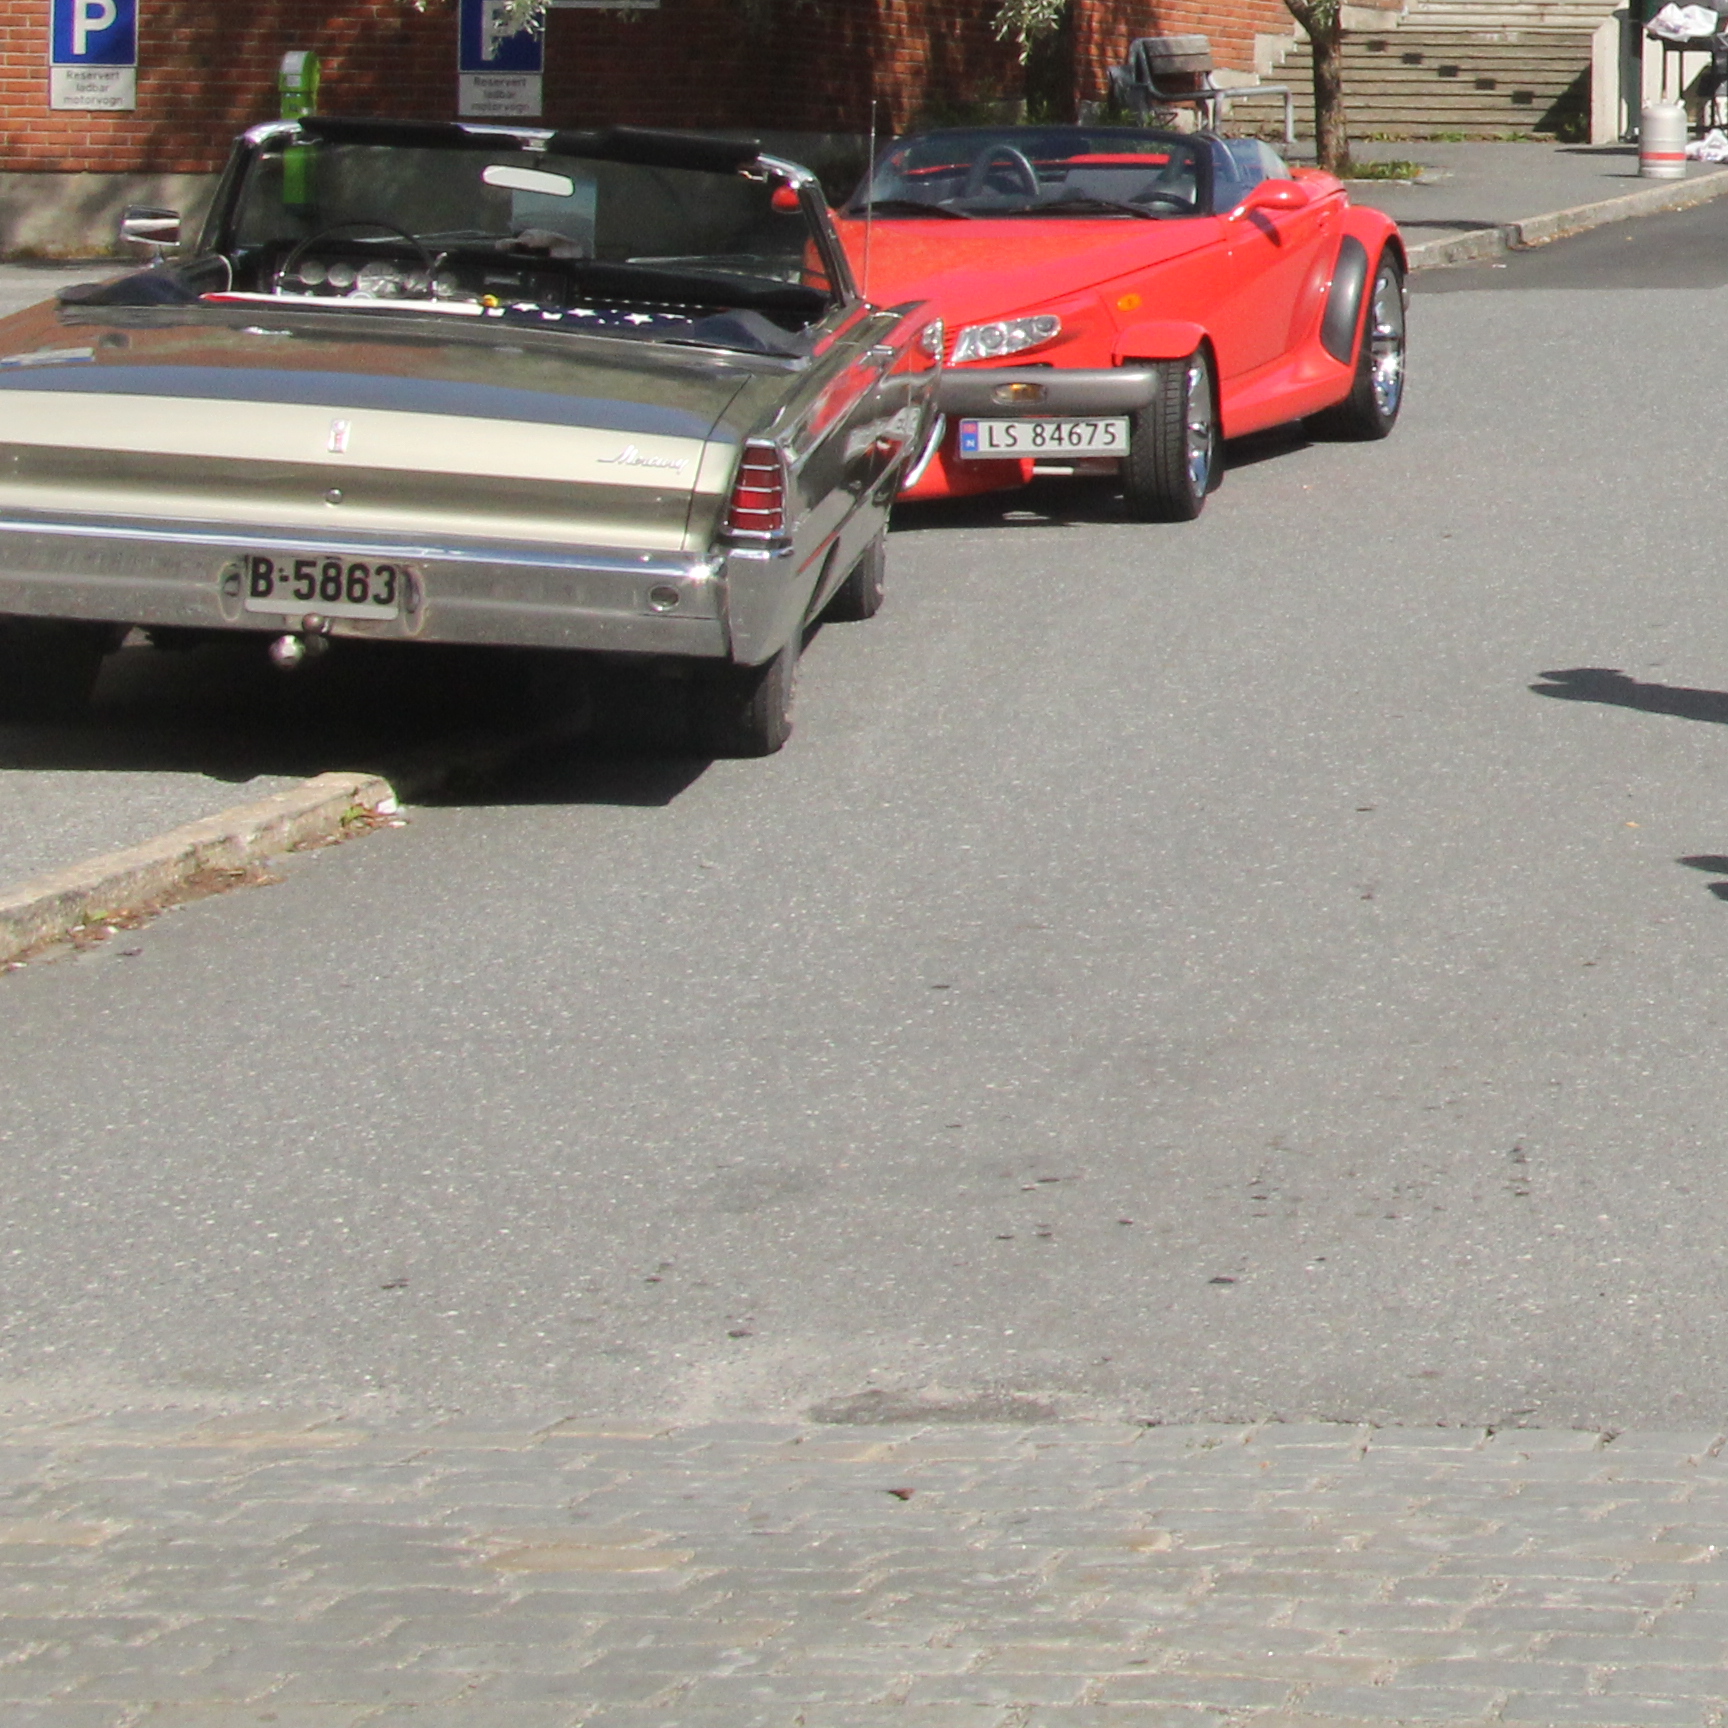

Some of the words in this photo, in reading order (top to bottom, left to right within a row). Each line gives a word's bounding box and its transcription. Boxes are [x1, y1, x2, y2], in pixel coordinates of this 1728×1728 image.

[66, 71, 119, 80] Reservert
[76, 83, 109, 92] ladbar
[64, 95, 123, 107] motorvogn
[988, 425, 1018, 448] LS
[1032, 422, 1117, 447] 84675
[597, 444, 689, 475] Mercury
